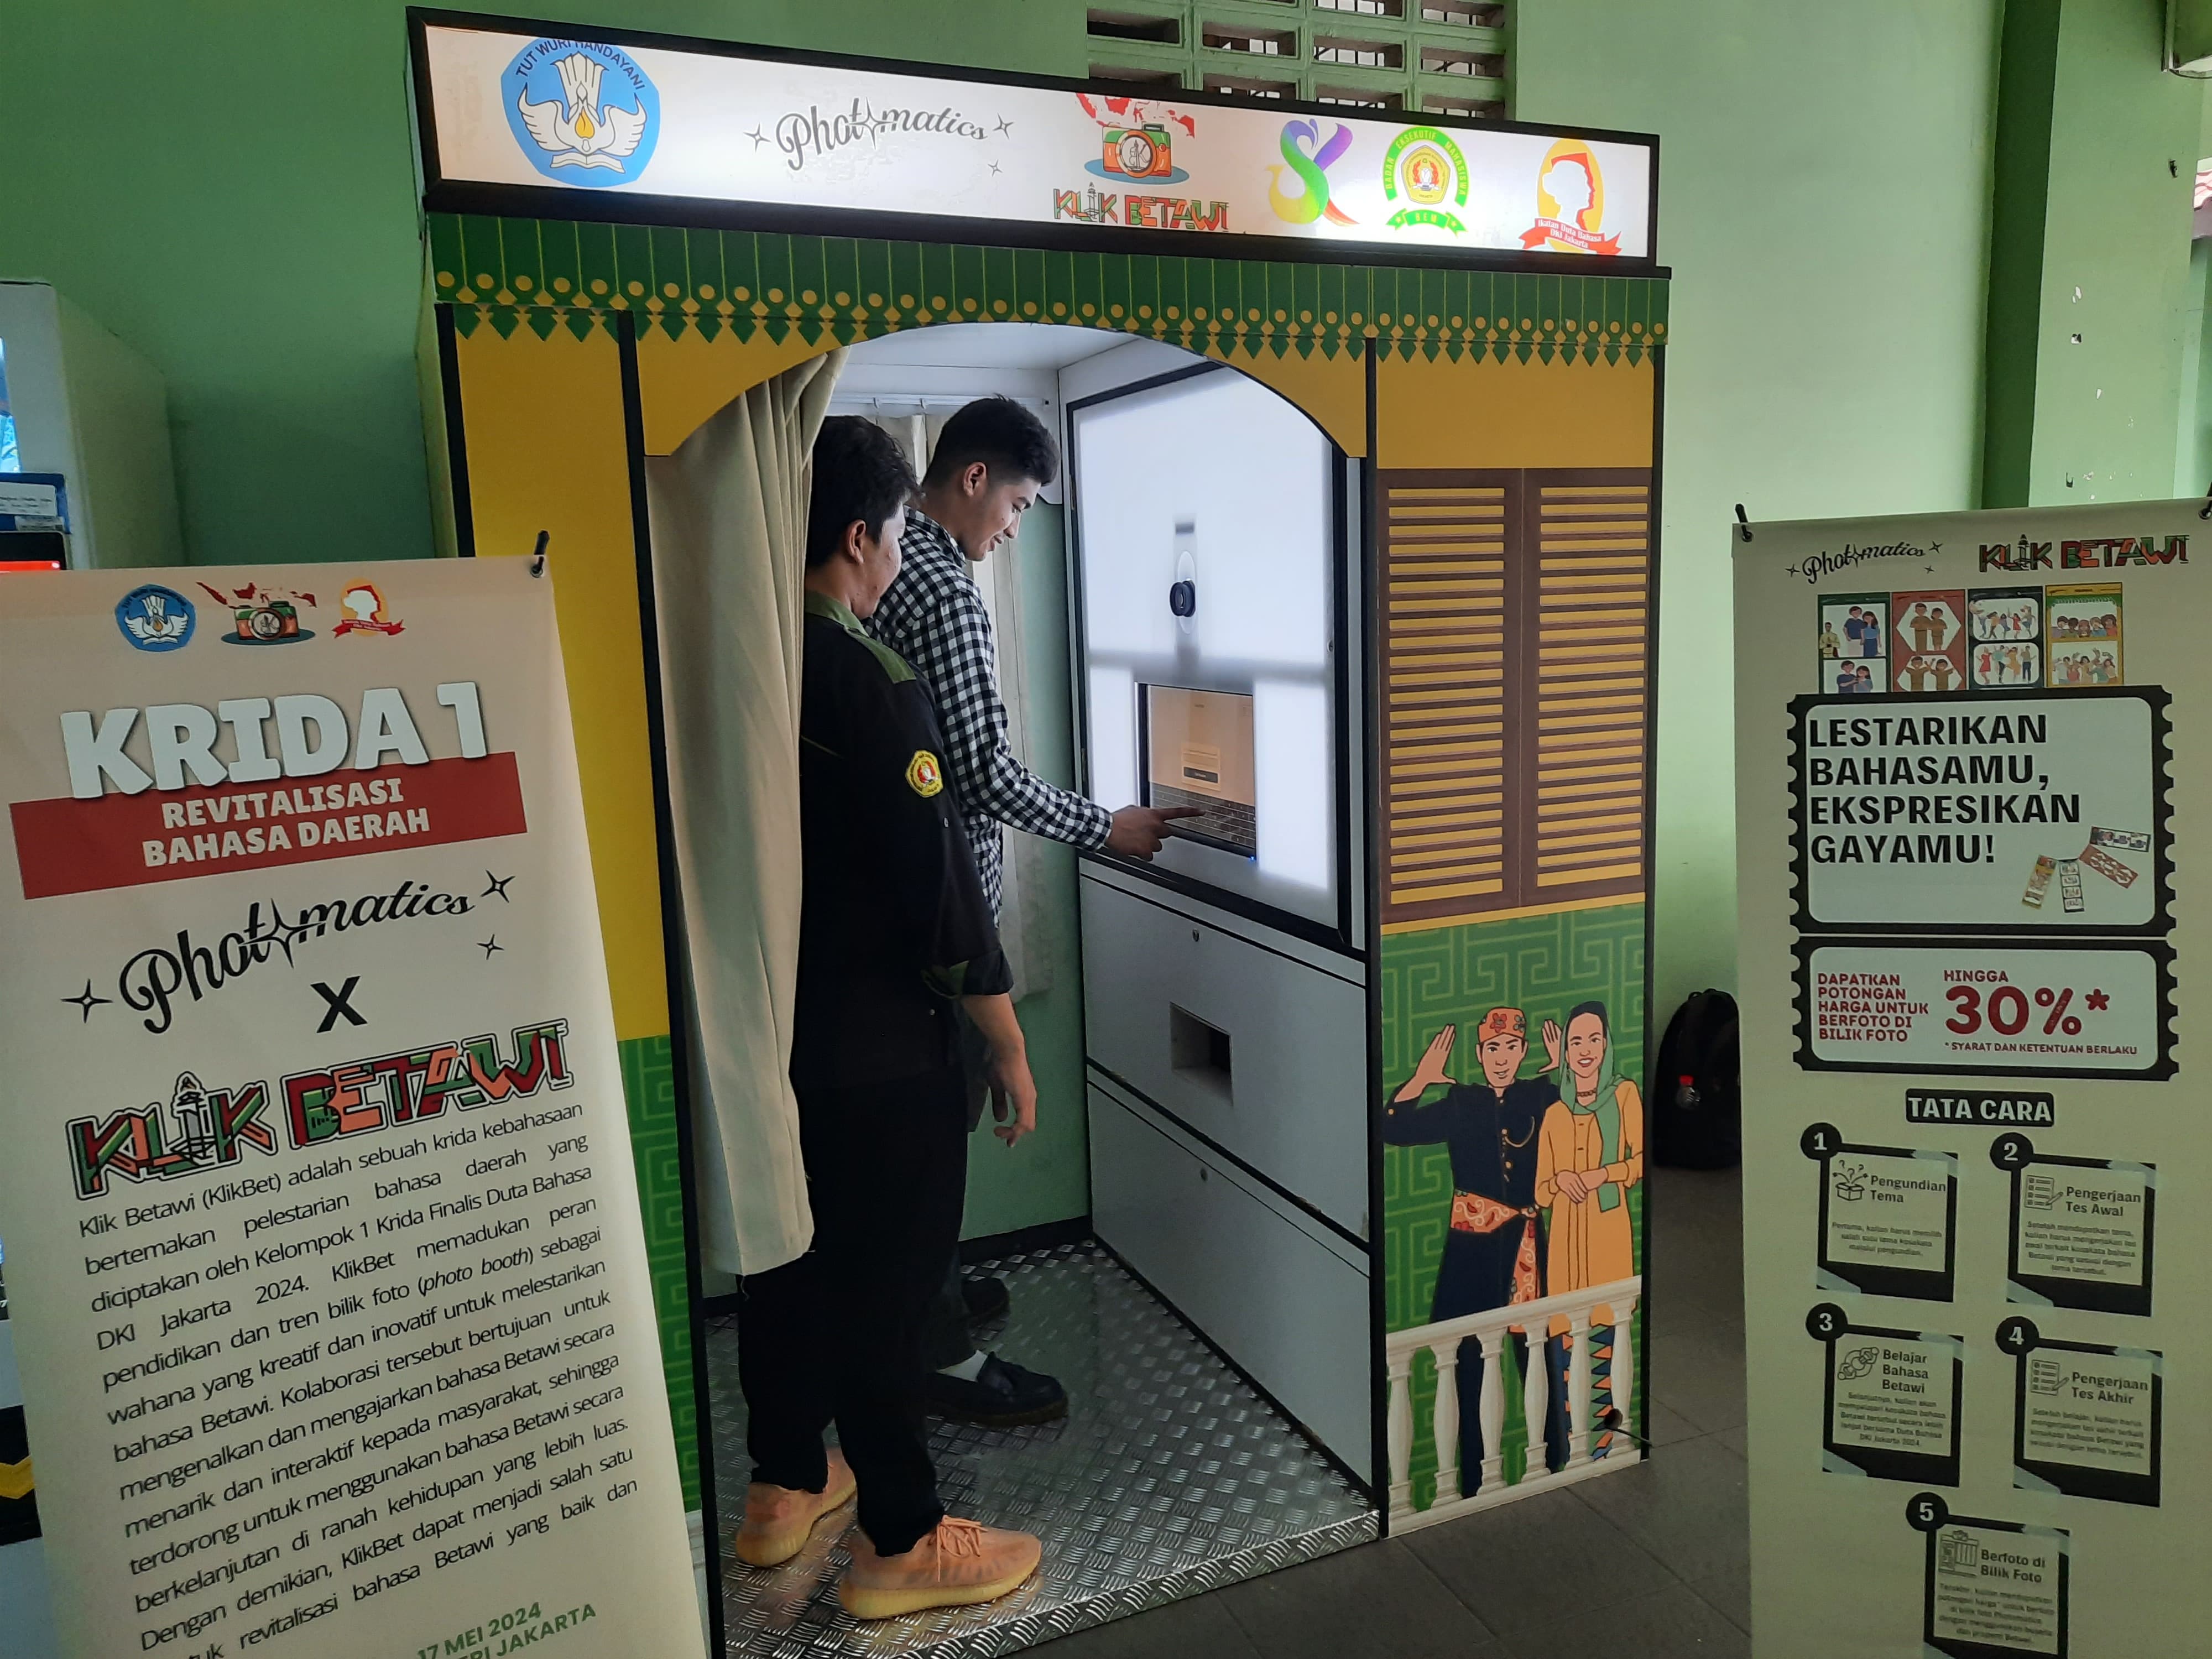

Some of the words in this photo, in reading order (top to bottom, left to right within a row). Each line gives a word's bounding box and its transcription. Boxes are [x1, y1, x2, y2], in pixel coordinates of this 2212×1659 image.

[515, 50, 538, 77] TUT
[535, 40, 571, 56] WURI
[576, 41, 645, 90] HANDAYANI
[1385, 157, 1395, 189] BADAN
[1396, 130, 1437, 149] EKSEKUTIF
[1444, 142, 1466, 195] MAHASISWA
[1053, 184, 1118, 224] KLIK
[1124, 195, 1229, 232] BETAWI
[1415, 213, 1437, 222] BEM
[1538, 219, 1559, 229] Ikatan
[1561, 223, 1575, 236] Duta
[1578, 231, 1602, 242] Bahasa
[1550, 228, 1562, 238] DKI
[1564, 233, 1588, 248] Jakarta
[1979, 535, 2053, 572] KLIK
[2060, 535, 2190, 570] BETAWI
[60, 688, 429, 799] KRIDA
[437, 681, 488, 758] 1
[1809, 713, 2047, 748] LESTARIKAN
[1810, 754, 2049, 791] BAHASAMU,
[161, 778, 404, 829] REVITALISASI
[1810, 793, 2080, 825] EKSPRESIKAN
[142, 825, 293, 868] BAHASA
[298, 807, 430, 847] DAERAH
[1810, 833, 1995, 864] GAYAMU!
[1818, 973, 1900, 985] DAPATKAN
[1944, 970, 2009, 983] HINGGA
[1818, 987, 1906, 1000] POTONGAN
[1818, 1000, 1871, 1013] HARGA
[1876, 1001, 1929, 1014] UNTUK
[1819, 1014, 1891, 1027] BERFOTO
[1895, 1016, 1912, 1028] DI
[1819, 1028, 1863, 1040] BILIK
[1866, 1029, 1908, 1042] FOTO
[1994, 1042, 2017, 1052] DAN
[2020, 1043, 2084, 1053] KETENTUAN
[2086, 1045, 2137, 1055] BERLAKU
[67, 1073, 276, 1199] KLIK
[281, 1019, 572, 1149] BETAWI
[1908, 1097, 1973, 1120] TATA
[1979, 1099, 2053, 1122] CARA
[1814, 1132, 1828, 1151] 1
[2004, 1142, 2018, 1161] 2
[79, 1213, 119, 1238] Klik
[124, 1192, 196, 1227] Betawi
[202, 1172, 281, 1211] (KlikBet)
[288, 1156, 352, 1186] adalah
[358, 1138, 427, 1169] sebuah
[432, 1127, 477, 1151] krida
[482, 1104, 583, 1140] kebahasaan
[1871, 1175, 1947, 1192] Pengundian
[85, 1229, 217, 1275] bertemakan
[243, 1195, 350, 1239] pelestarian
[374, 1172, 442, 1200] bahasa
[465, 1148, 527, 1177] daerah
[546, 1135, 589, 1161] yang
[1870, 1190, 1904, 1203] Tema
[2067, 1186, 2141, 1203] Pengerjaan
[2066, 1201, 2088, 1213] Tes
[2091, 1203, 2124, 1217] Awal
[91, 1271, 200, 1312] diciptakan
[205, 1254, 249, 1281] oleh
[254, 1225, 356, 1267] Kelompok
[359, 1221, 369, 1238] 1
[376, 1208, 425, 1235] Krida
[429, 1194, 482, 1221] Finalis
[486, 1184, 528, 1206] Duta
[532, 1167, 592, 1194] Bahasa
[96, 1323, 136, 1350] DKI
[159, 1300, 232, 1338] Jakarta
[254, 1275, 309, 1305] 2024.
[331, 1251, 397, 1283] KlikBet
[416, 1217, 530, 1259] memadukan
[549, 1198, 597, 1228] peran
[102, 1340, 221, 1394] pendidikan
[230, 1326, 270, 1349] dan
[277, 1311, 319, 1334] tren
[327, 1294, 366, 1319] bilik
[371, 1285, 410, 1306] foto
[418, 1266, 473, 1298] (photo
[481, 1246, 534, 1276] booth)
[540, 1225, 601, 1259] sebagai
[1819, 1313, 1833, 1332] 3
[107, 1386, 196, 1425] wahana
[202, 1367, 255, 1401] yang
[259, 1341, 321, 1377] kreatif
[327, 1333, 365, 1355] dan
[371, 1305, 438, 1343] inovatif
[444, 1291, 497, 1320] untuk
[502, 1261, 606, 1303] melestarikan
[2008, 1327, 2025, 1345] 4
[1883, 1349, 1928, 1364] Belajar
[113, 1425, 194, 1463] bahasa
[201, 1395, 275, 1434] Betawi.
[280, 1359, 380, 1407] Kolaborasi
[386, 1336, 463, 1373] tersebut
[468, 1311, 552, 1347] bertujuan
[564, 1289, 611, 1317] untuk
[1882, 1364, 1929, 1379] Bahasa
[2072, 1371, 2148, 1391] Pengerjaan
[1882, 1379, 1925, 1394] Betawi
[2072, 1387, 2094, 1400] Tes
[2098, 1390, 2135, 1405] Akhir
[119, 1439, 264, 1501] mengenalkan
[267, 1425, 307, 1448] dan
[309, 1383, 434, 1434] mengajarkan
[435, 1360, 501, 1392] bahasa
[503, 1337, 561, 1370] Betawi
[563, 1323, 615, 1351] secara
[124, 1491, 216, 1538] menarik
[223, 1477, 263, 1501] dan
[270, 1438, 356, 1485] interaktif
[361, 1417, 431, 1453] kepada
[438, 1380, 542, 1427] masyarakat,
[548, 1355, 619, 1390] sehingga
[128, 1522, 240, 1575] terdorong
[243, 1497, 304, 1532] untuk
[306, 1451, 441, 1509] menggunakan
[445, 1427, 510, 1459] bahasa
[512, 1401, 570, 1436] Betawi
[572, 1386, 624, 1415] secara
[134, 1546, 280, 1614] berkelanjutan
[291, 1529, 310, 1551] di
[321, 1506, 378, 1541] ranah
[387, 1470, 484, 1516] kehidupan
[493, 1451, 537, 1482] yang
[544, 1432, 585, 1459] lebih
[593, 1418, 629, 1441] luas.
[1919, 1502, 1934, 1522] 5
[140, 1605, 227, 1651] Dengan
[236, 1564, 332, 1611] demikian,
[341, 1532, 405, 1569] KlikBet
[412, 1510, 466, 1542] dapat
[472, 1479, 542, 1520] menjadi
[549, 1462, 593, 1491] salah
[599, 1448, 633, 1472] satu
[1981, 1549, 2028, 1566] Berfoto
[2032, 1554, 2046, 1568] di
[1980, 1564, 2010, 1579] Bilik
[2013, 1569, 2042, 1583] Foto
[418, 1644, 439, 1659] 17
[444, 1626, 483, 1656] MEI
[488, 1601, 542, 1637] 2024
[496, 1604, 596, 1657] JAKARTA
